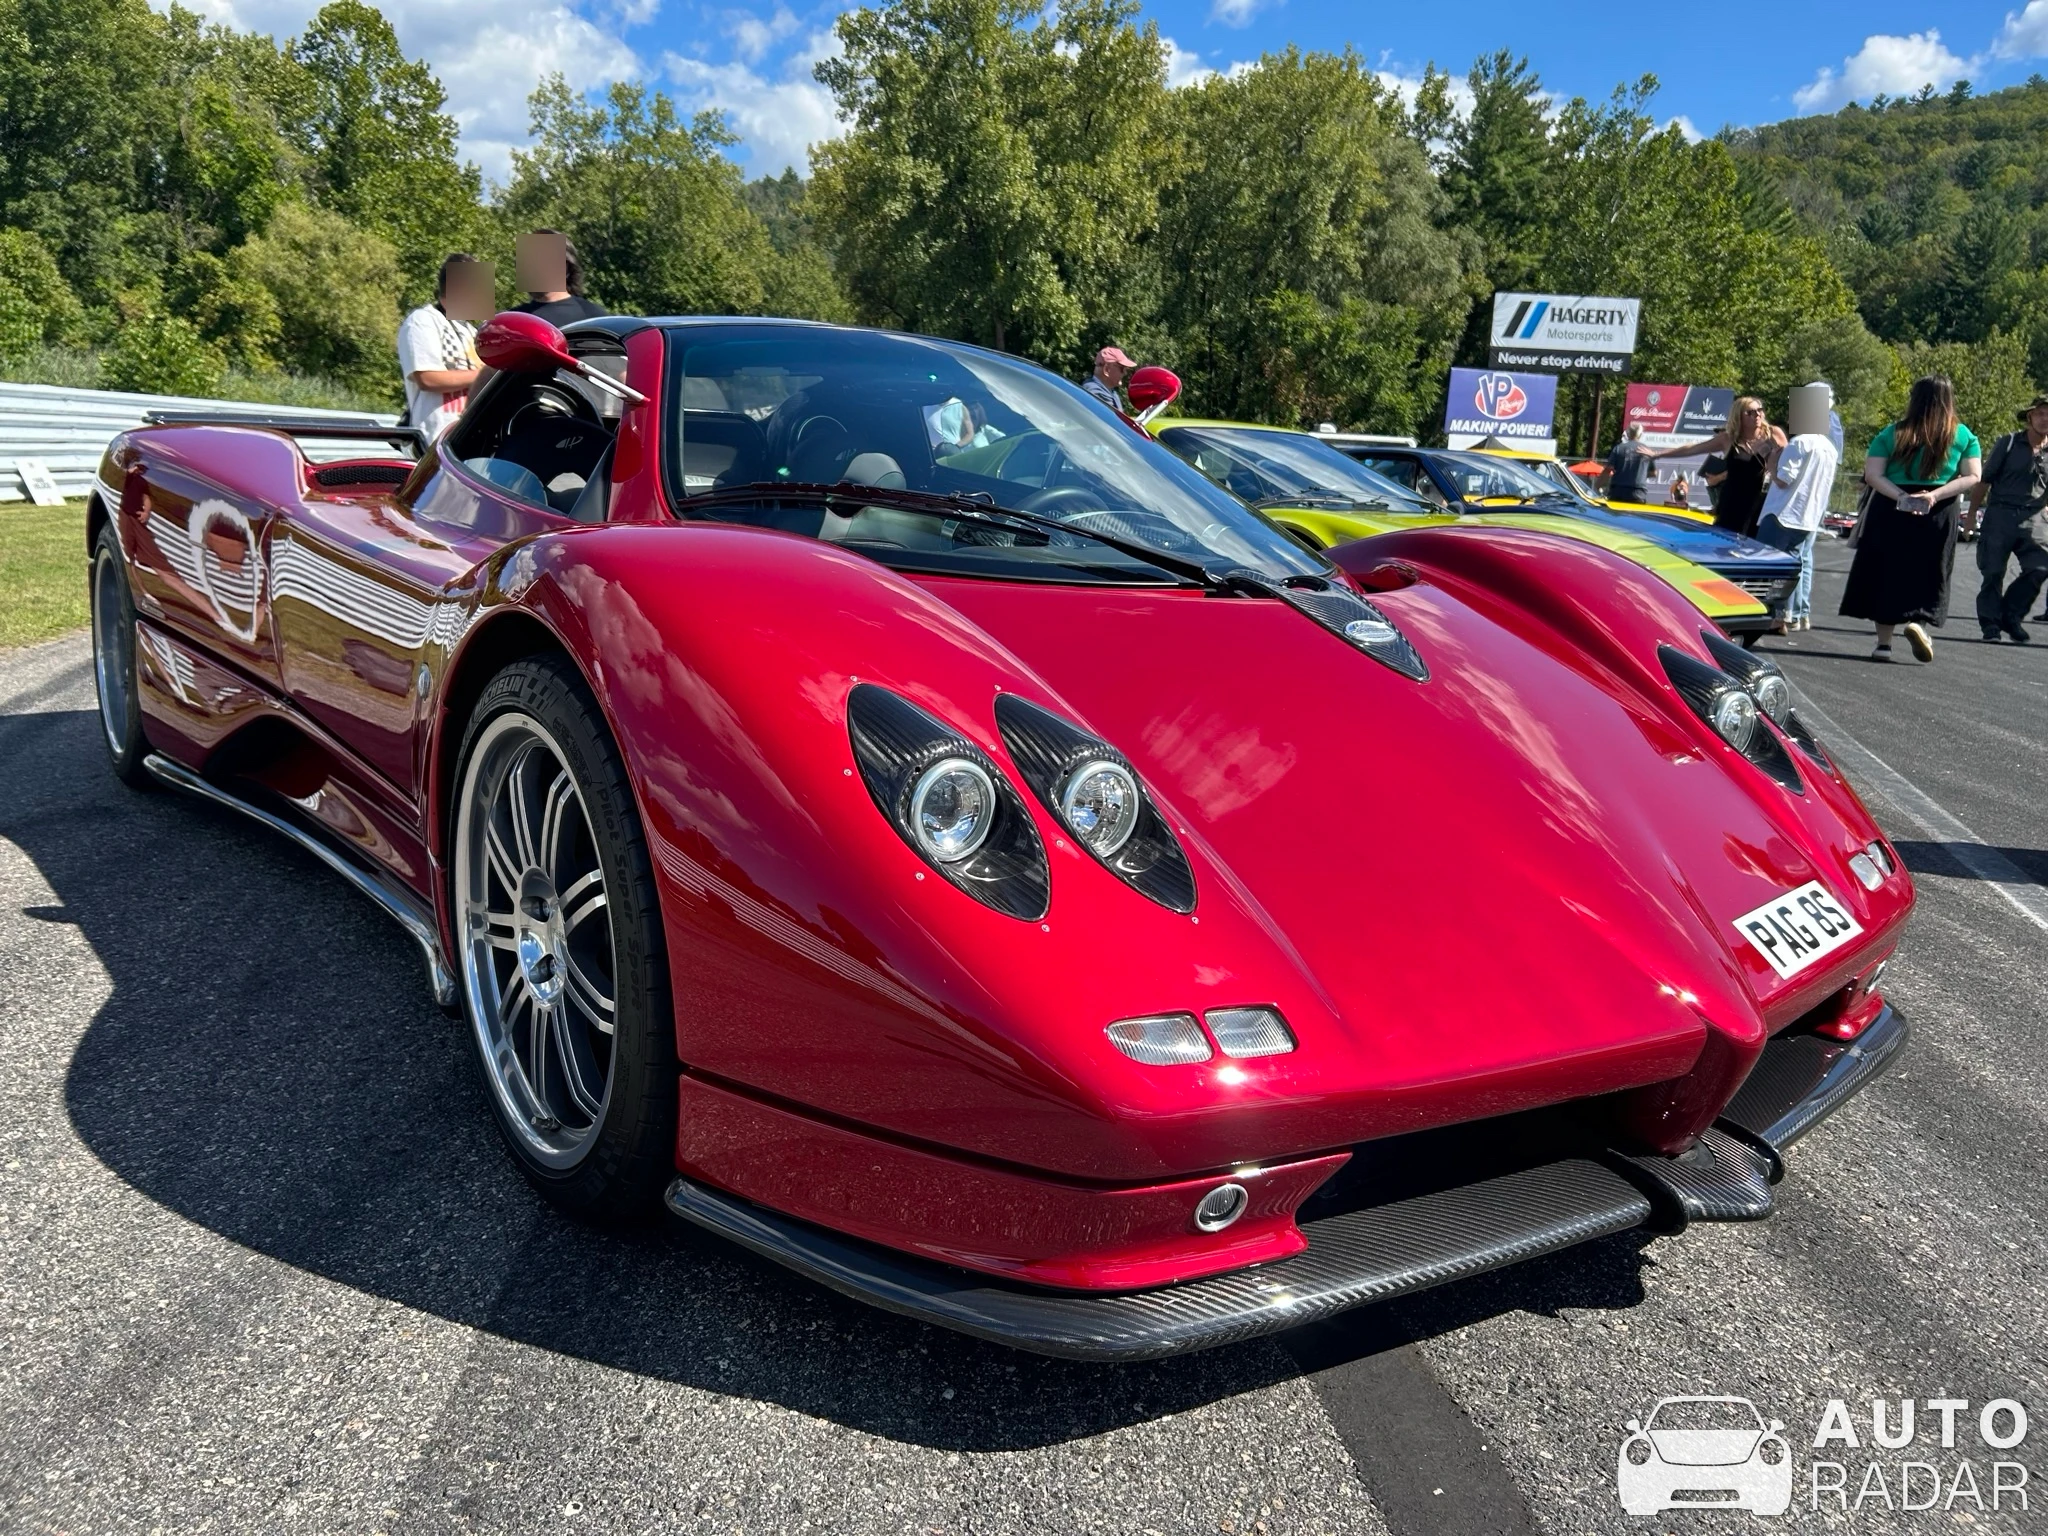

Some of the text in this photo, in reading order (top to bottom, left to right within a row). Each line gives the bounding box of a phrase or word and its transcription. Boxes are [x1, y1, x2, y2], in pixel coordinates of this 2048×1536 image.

[1550, 307, 1627, 326] HAGERTY
[1547, 328, 1614, 343] Motorsports
[1498, 352, 1624, 372] Never stop driving
[1478, 373, 1514, 418] VP
[1449, 419, 1551, 437] MAKIN' POWER!
[1745, 906, 1821, 968] PAG
